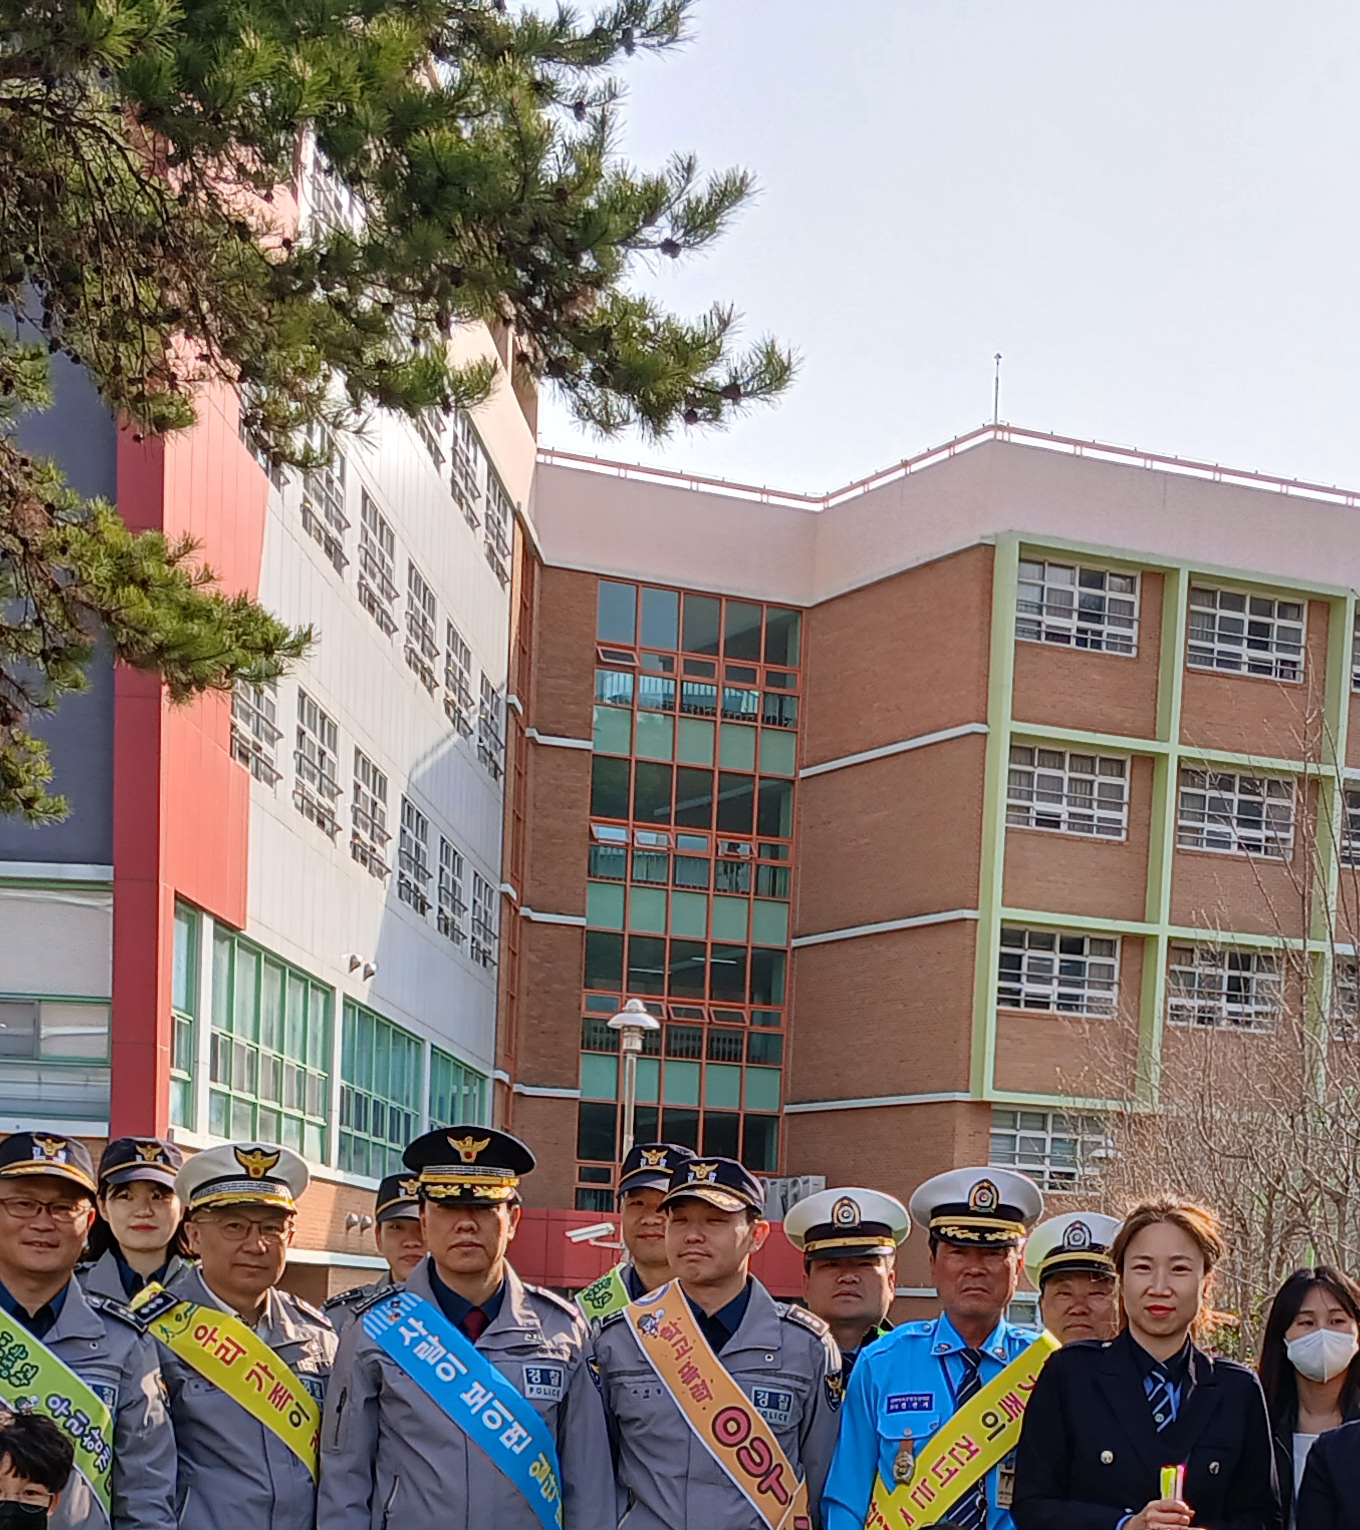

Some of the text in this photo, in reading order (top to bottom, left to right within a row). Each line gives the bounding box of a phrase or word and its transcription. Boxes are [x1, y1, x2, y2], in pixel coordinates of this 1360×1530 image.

[659, 1317, 694, 1361] 학교
[194, 1325, 248, 1367] 우리
[245, 1361, 311, 1428] 가족이
[398, 1316, 469, 1383] 사람이
[460, 1381, 534, 1456] 보이면
[528, 1369, 560, 1386] 경찰
[529, 1386, 561, 1397] POLICE
[46, 1393, 90, 1437] 우리
[712, 1406, 791, 1506] OUT
[909, 1434, 982, 1511] 건너는
